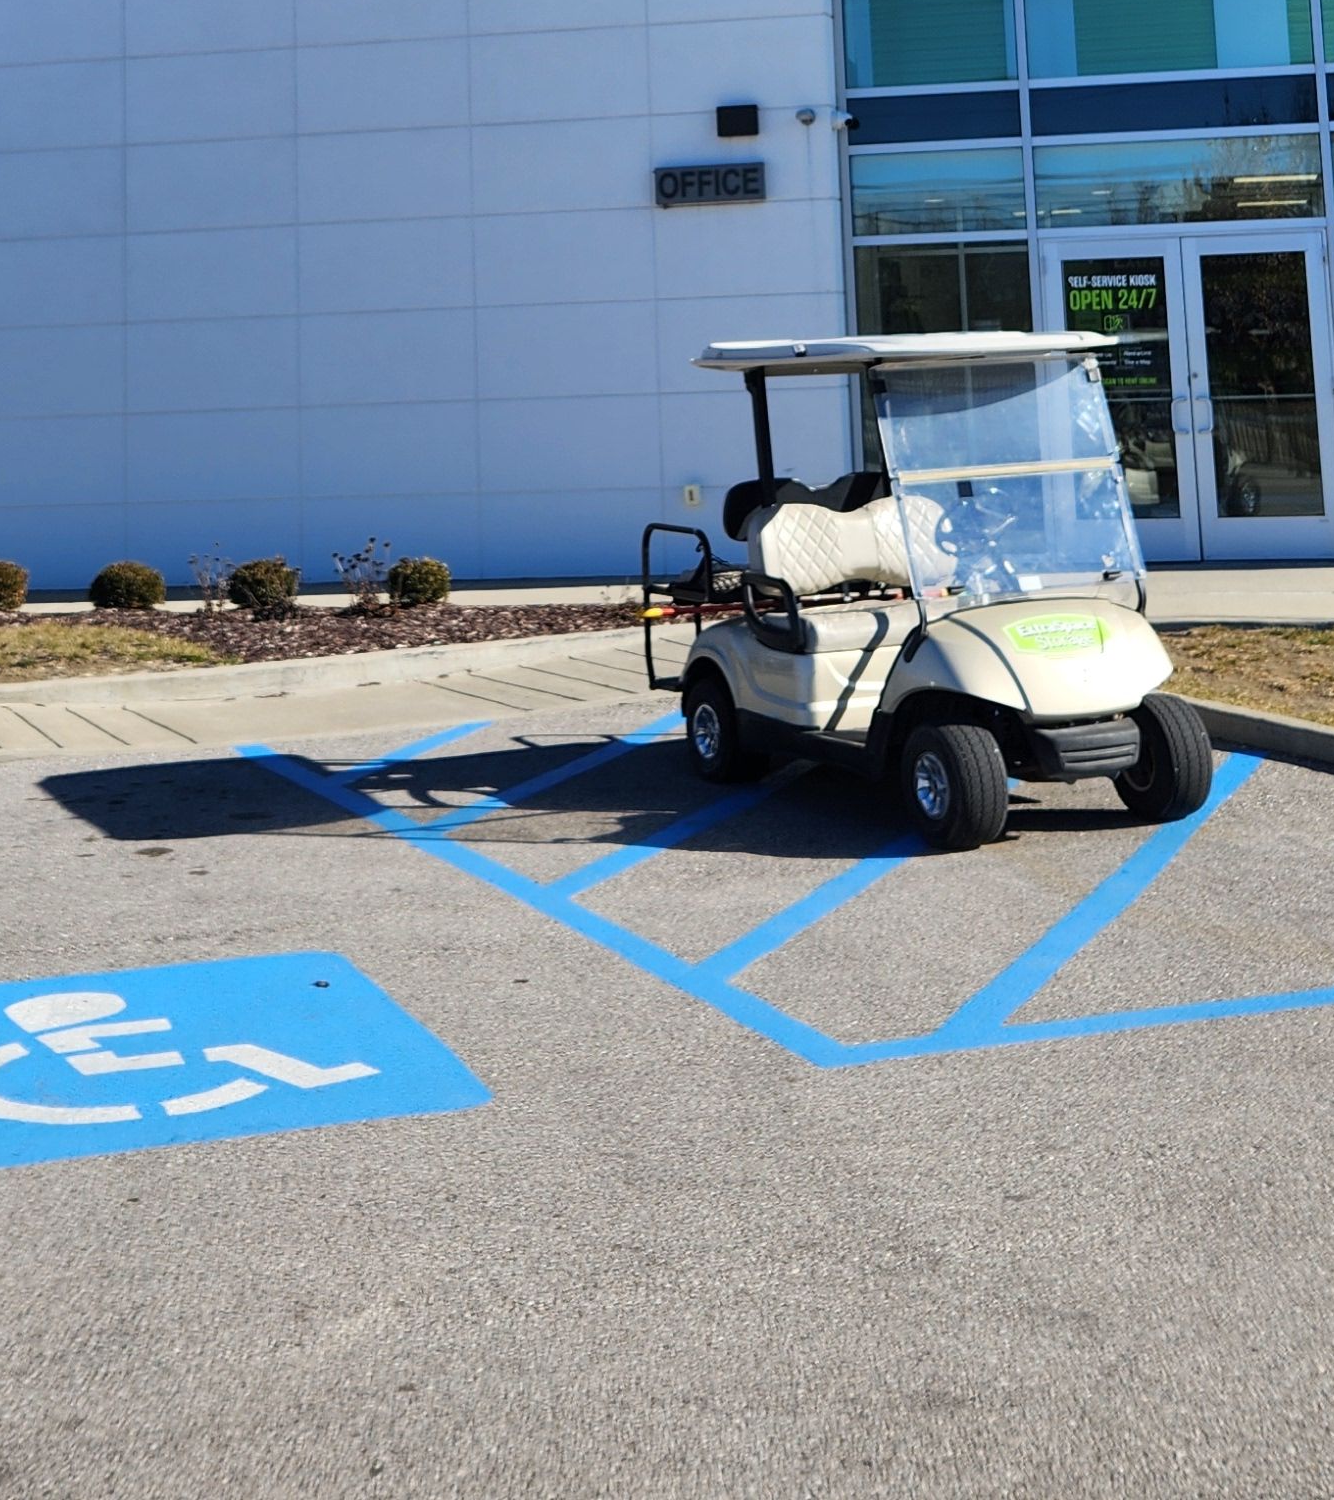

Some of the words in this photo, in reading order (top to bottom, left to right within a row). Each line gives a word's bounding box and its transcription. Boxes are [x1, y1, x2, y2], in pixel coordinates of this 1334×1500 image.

[658, 167, 760, 199] OFFICE
[1067, 274, 1128, 288] SELF-SERVICE
[1129, 274, 1156, 287] KIOSK
[1069, 288, 1113, 311] OPEN
[1117, 288, 1157, 309] 24/7
